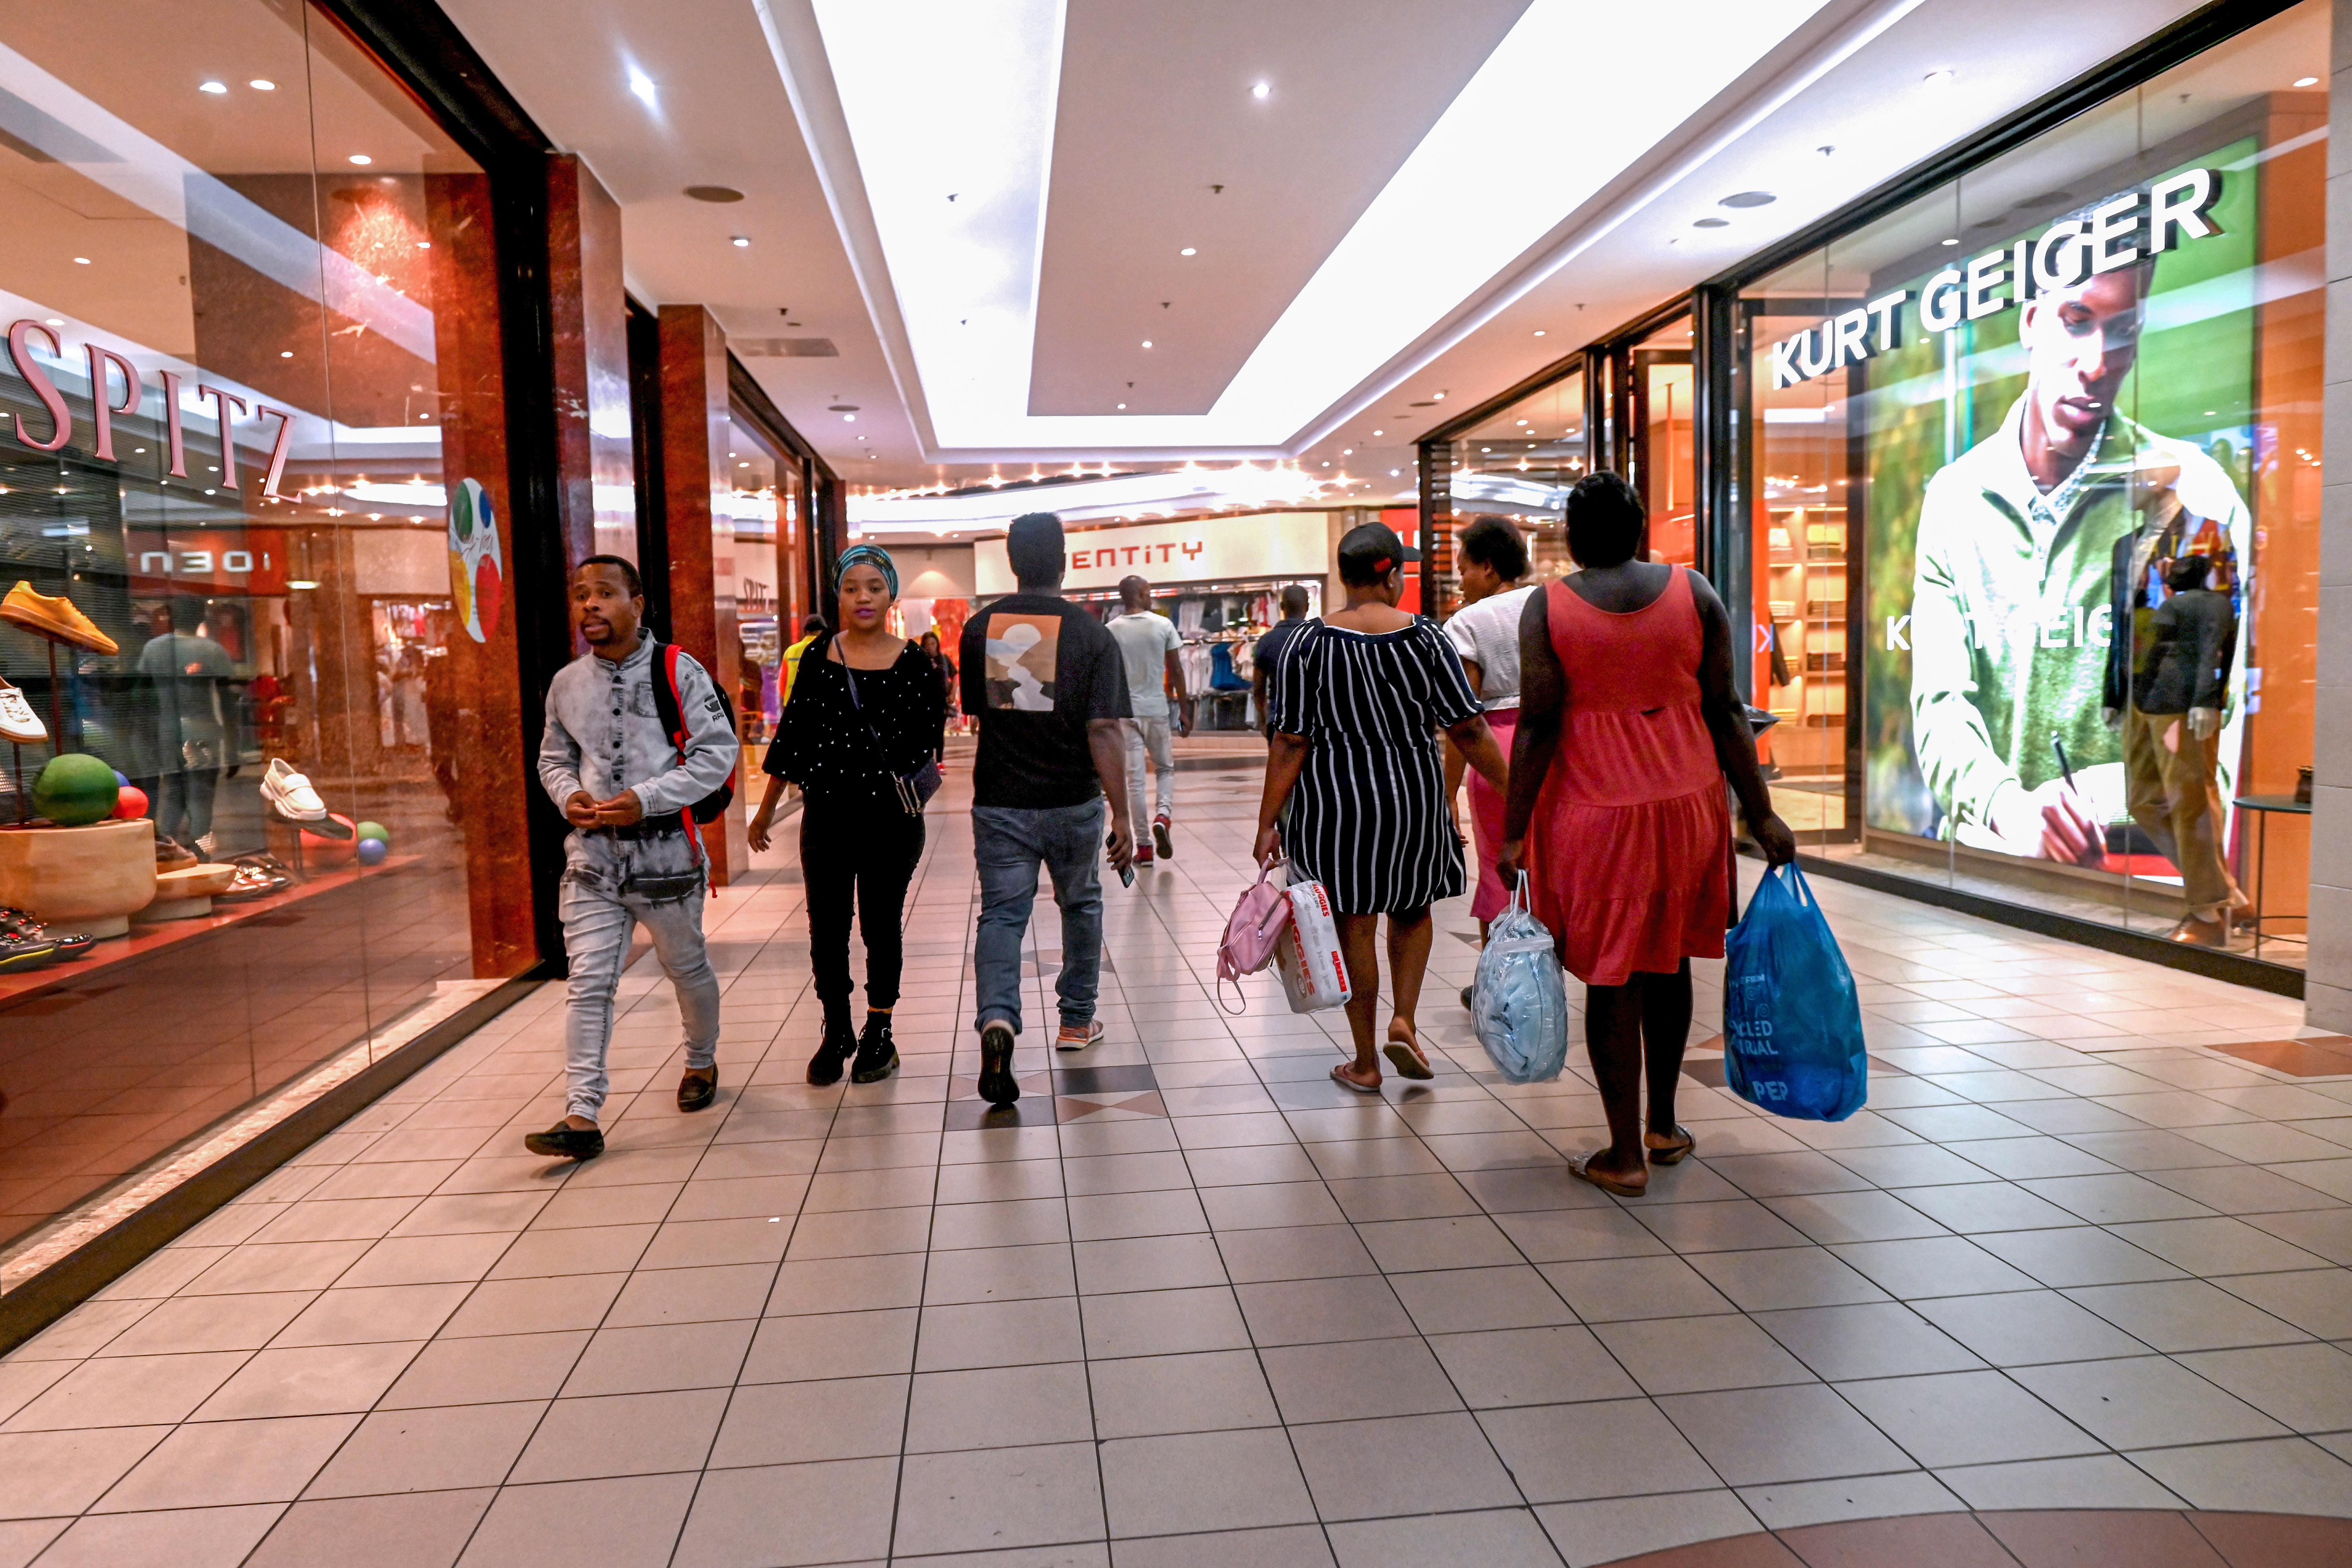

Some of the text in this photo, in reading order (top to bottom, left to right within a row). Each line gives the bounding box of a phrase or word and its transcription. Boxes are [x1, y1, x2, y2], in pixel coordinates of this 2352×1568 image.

[1773, 168, 2212, 390] KURT GEIGER
[9, 320, 301, 504] SPITZ
[1752, 1080, 1789, 1101] PEP
